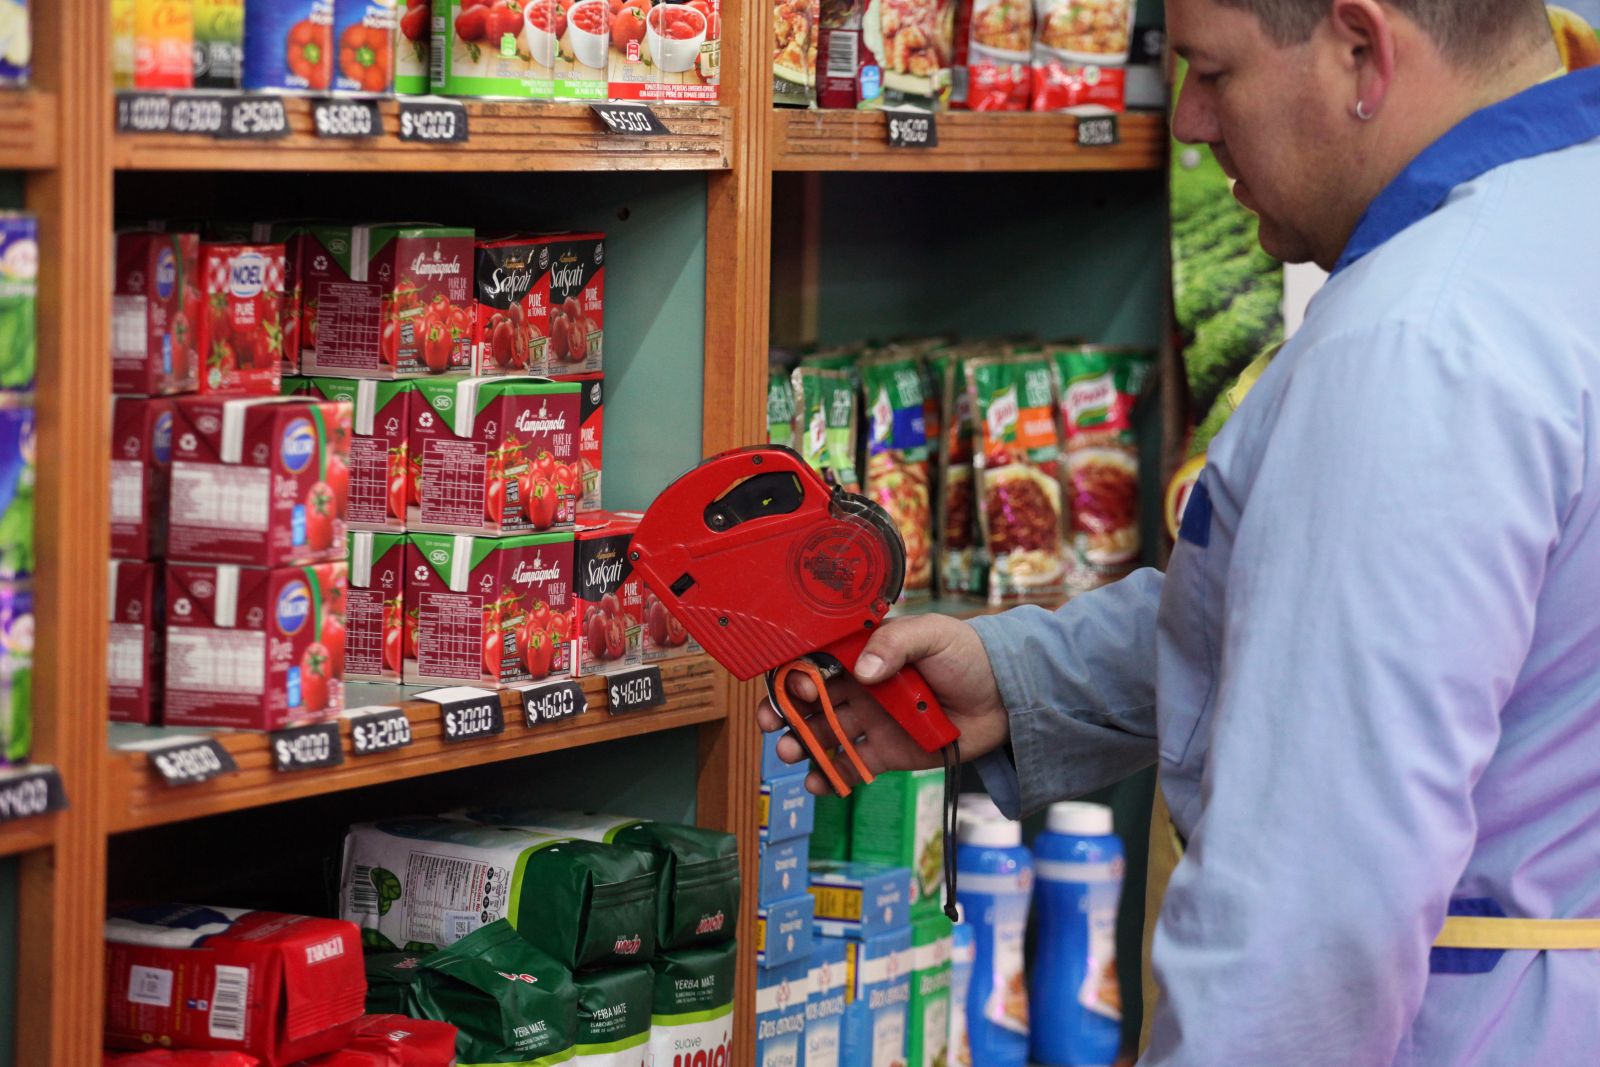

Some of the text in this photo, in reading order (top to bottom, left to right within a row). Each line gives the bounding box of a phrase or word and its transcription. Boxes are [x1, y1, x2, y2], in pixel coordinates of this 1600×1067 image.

[520, 409, 565, 438] Campagnola
[431, 552, 446, 562] SIG
[516, 561, 560, 588] Campagnola
[585, 558, 624, 594] Salsati
[611, 677, 652, 707] $46.00
[528, 689, 574, 723] $46.00
[675, 975, 714, 990] YERBA MATE
[593, 1003, 627, 1020] YERBA MATE
[529, 1020, 547, 1034] MATE
[674, 1036, 702, 1050] suave
